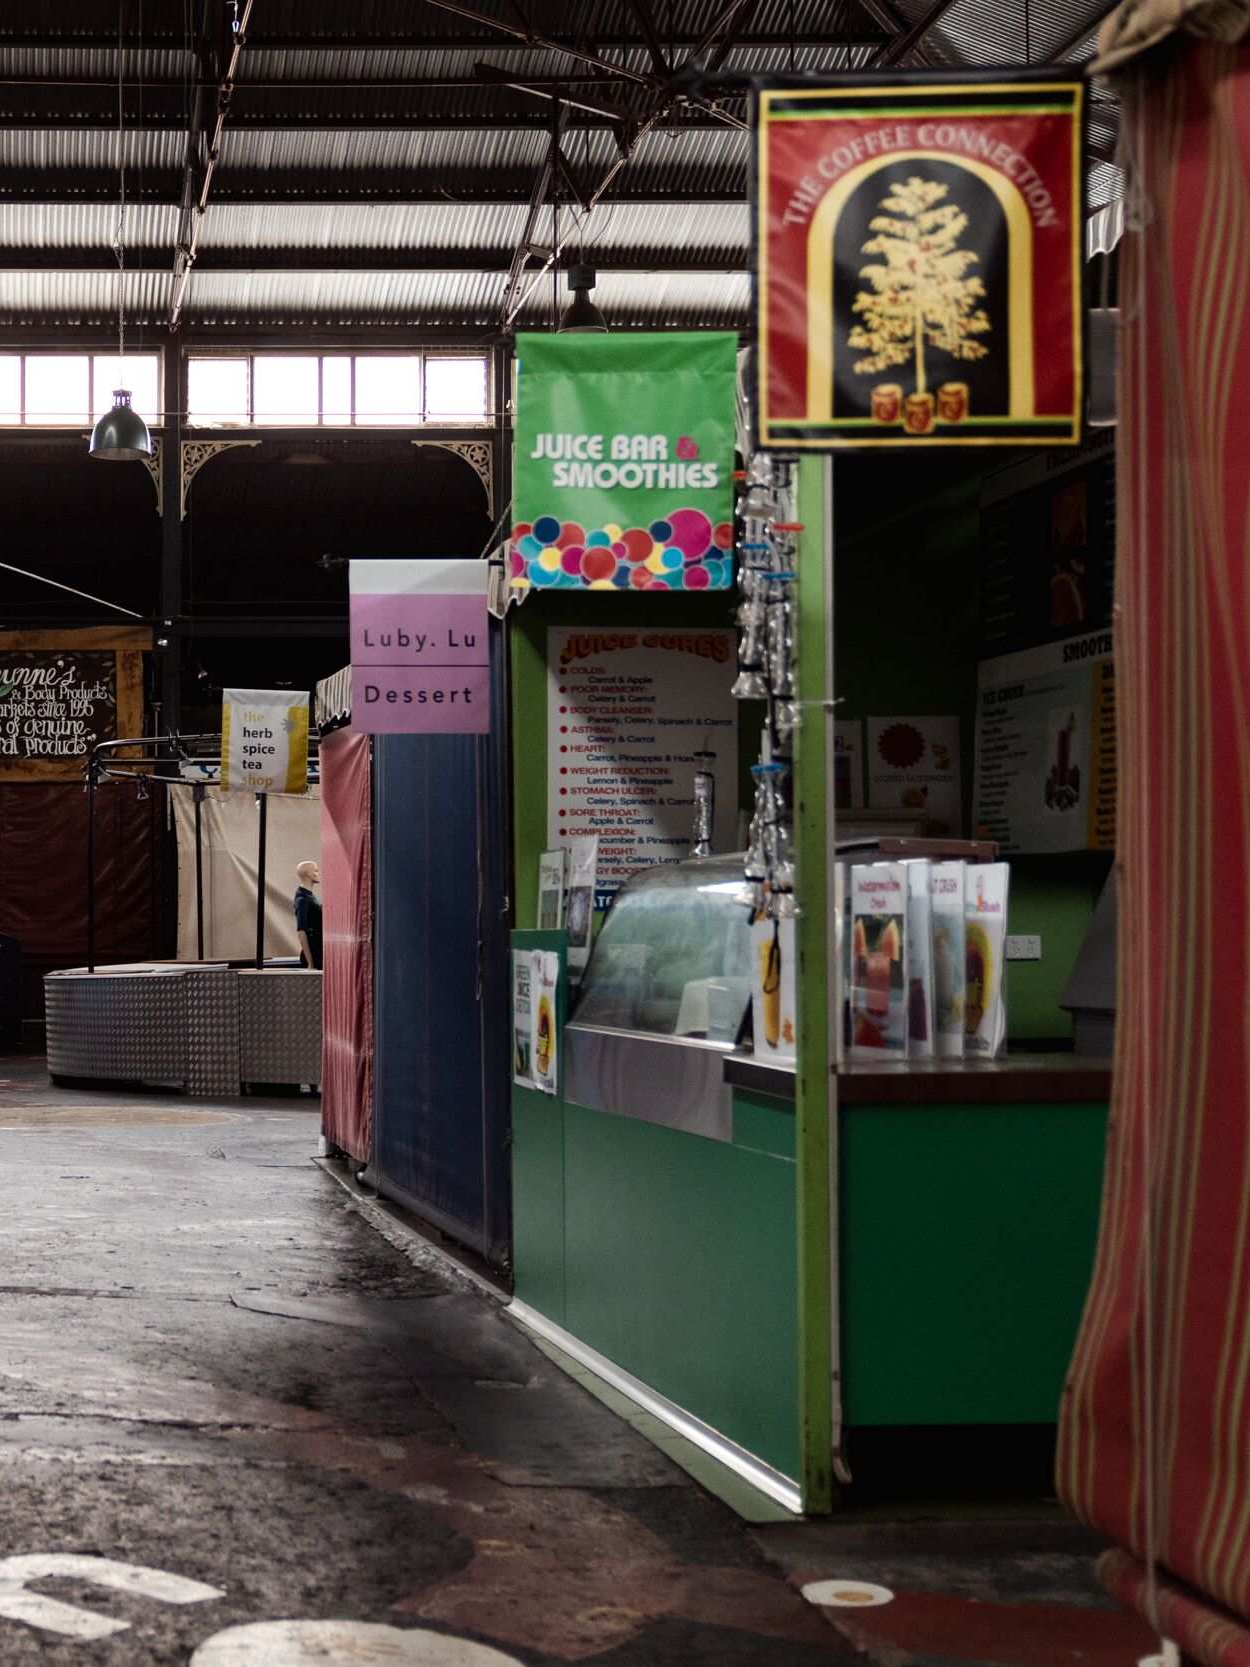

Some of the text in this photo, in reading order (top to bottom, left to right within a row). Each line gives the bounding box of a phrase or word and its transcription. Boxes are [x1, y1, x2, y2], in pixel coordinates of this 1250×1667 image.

[784, 124, 1060, 229] THE COFFEE CONNECTION
[530, 433, 699, 460] JUICE BAR &
[552, 462, 719, 489] SMOOTHIES
[364, 628, 475, 653] Luby. Lu
[561, 633, 730, 665] JUICE CURES
[588, 676, 616, 684] Carrot
[626, 677, 654, 685] Apple
[11, 688, 21, 702] &
[22, 684, 56, 704] Body
[58, 681, 109, 702] Products
[365, 685, 472, 704] Dessert
[588, 695, 617, 704] Celery
[243, 711, 265, 722] the
[6, 715, 20, 737] of
[23, 717, 91, 739] genuine
[242, 726, 274, 739] herb
[587, 735, 616, 745] Celery
[626, 735, 655, 744] Carrot
[241, 743, 276, 757] spice
[241, 759, 263, 770] tea
[618, 754, 663, 764] Pineapple
[570, 767, 608, 775] WEIGHT
[242, 774, 274, 788] shop
[587, 777, 619, 786] Lemon
[629, 777, 673, 788] Pineapple
[570, 787, 620, 796] STOMACH
[619, 797, 657, 808] Spinach
[569, 809, 598, 817] SORE
[588, 818, 615, 827] Apple
[625, 817, 654, 826] Carrot
[646, 837, 691, 847] Pineapple
